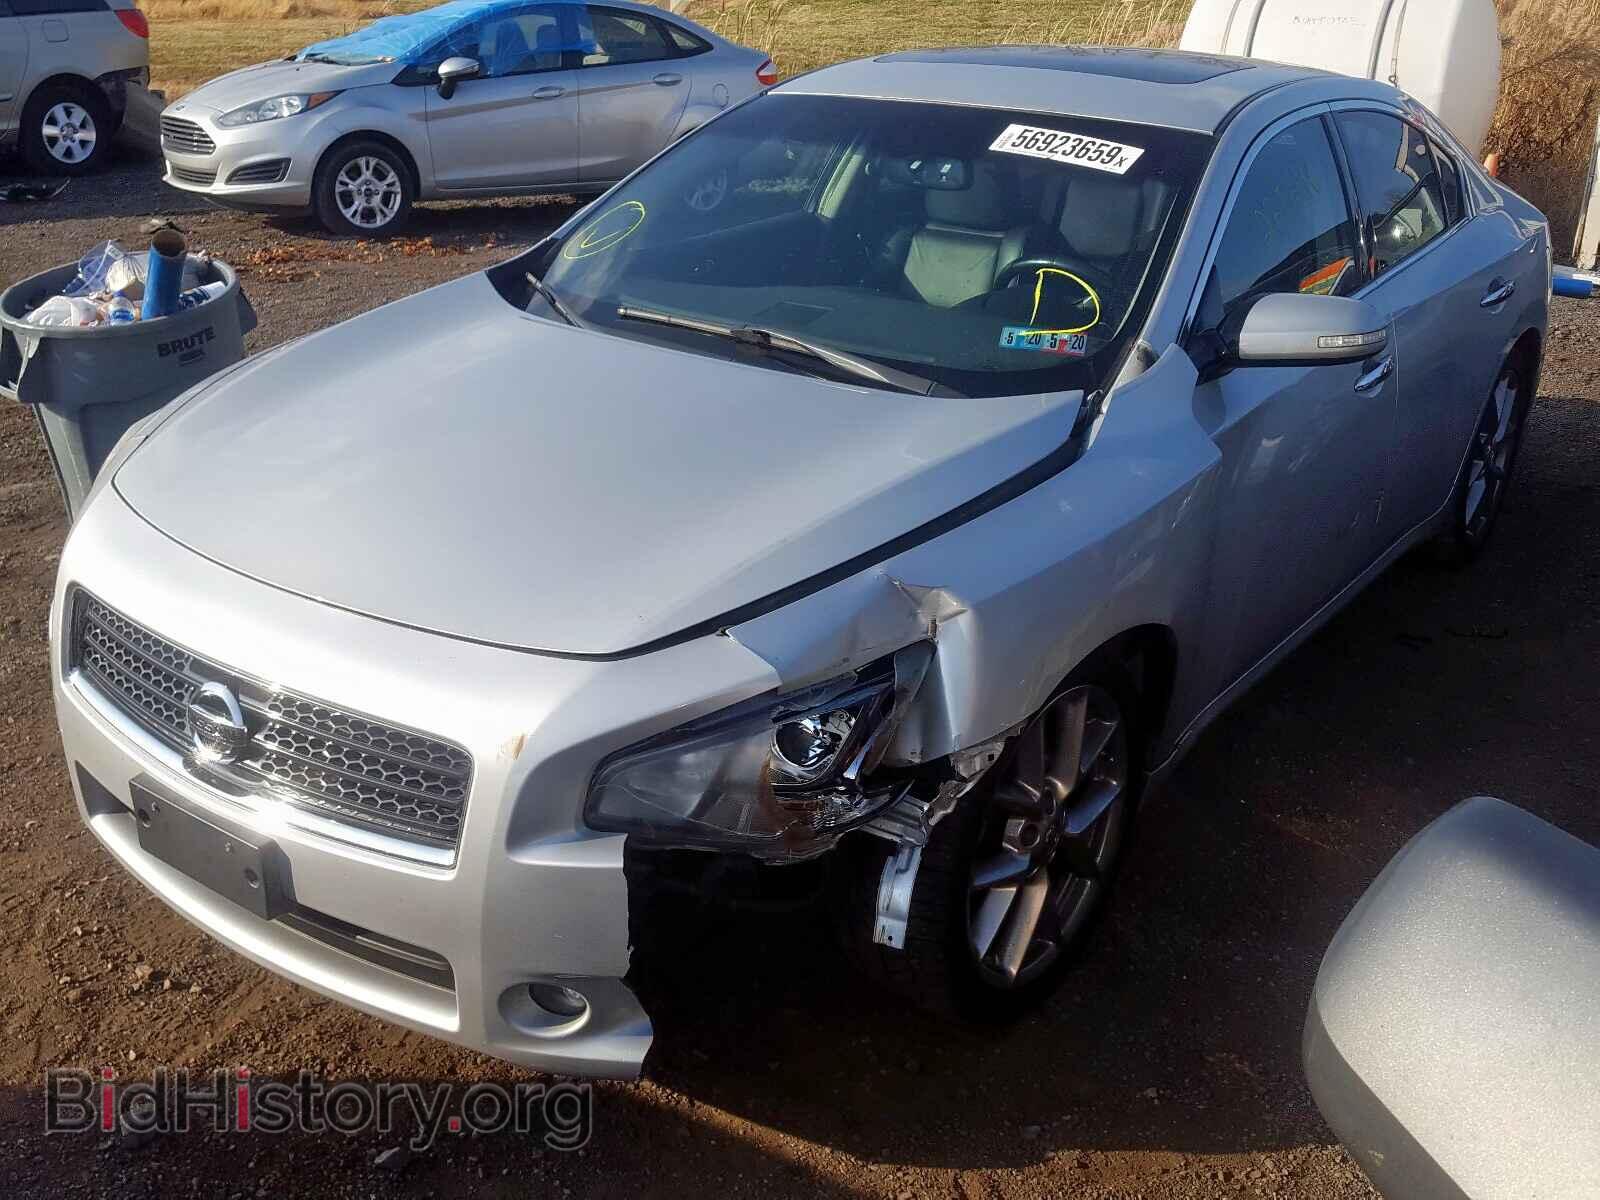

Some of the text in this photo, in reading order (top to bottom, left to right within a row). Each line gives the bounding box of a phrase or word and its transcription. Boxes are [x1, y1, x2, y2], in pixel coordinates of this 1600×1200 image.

[157, 325, 216, 357] BRUTE
[1050, 333, 1085, 350] 5 20
